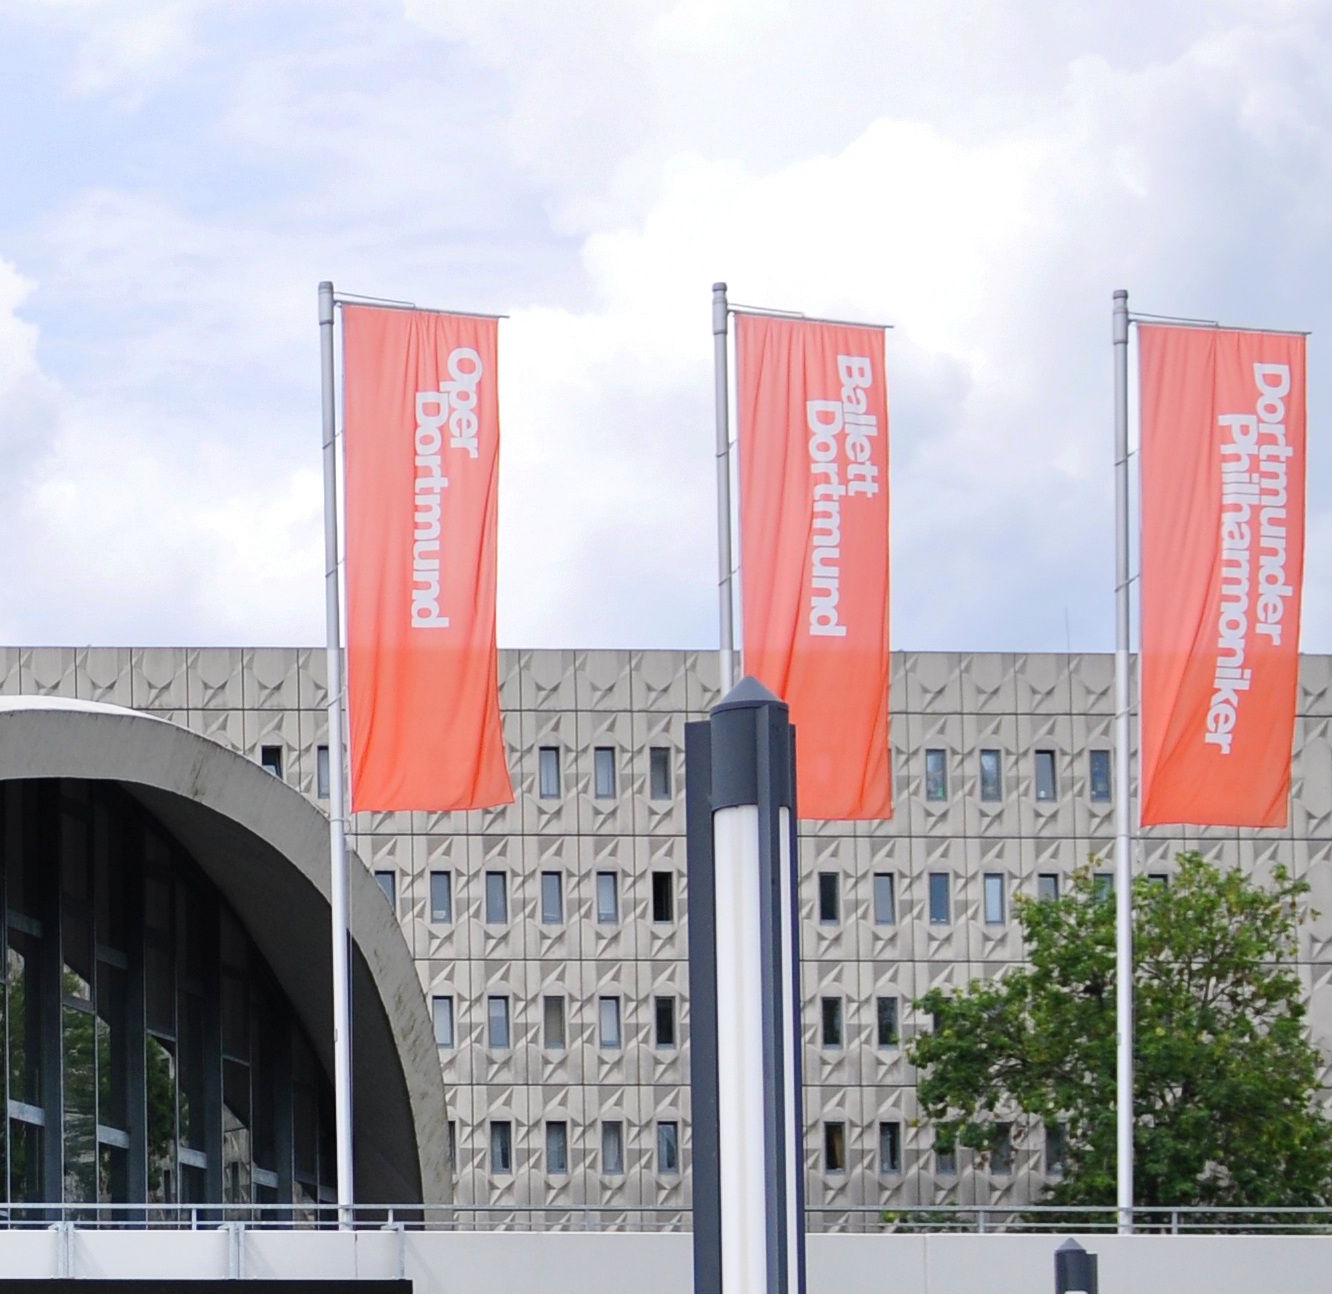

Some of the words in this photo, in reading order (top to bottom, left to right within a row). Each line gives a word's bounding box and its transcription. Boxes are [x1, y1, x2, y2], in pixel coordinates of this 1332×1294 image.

[411, 391, 450, 628] Dortmund
[440, 347, 483, 459] Oper
[806, 400, 847, 637] Dortmund
[837, 354, 879, 498] Ballett
[1253, 362, 1293, 646] Dortmunder
[1204, 413, 1261, 755] Philharmoniker
